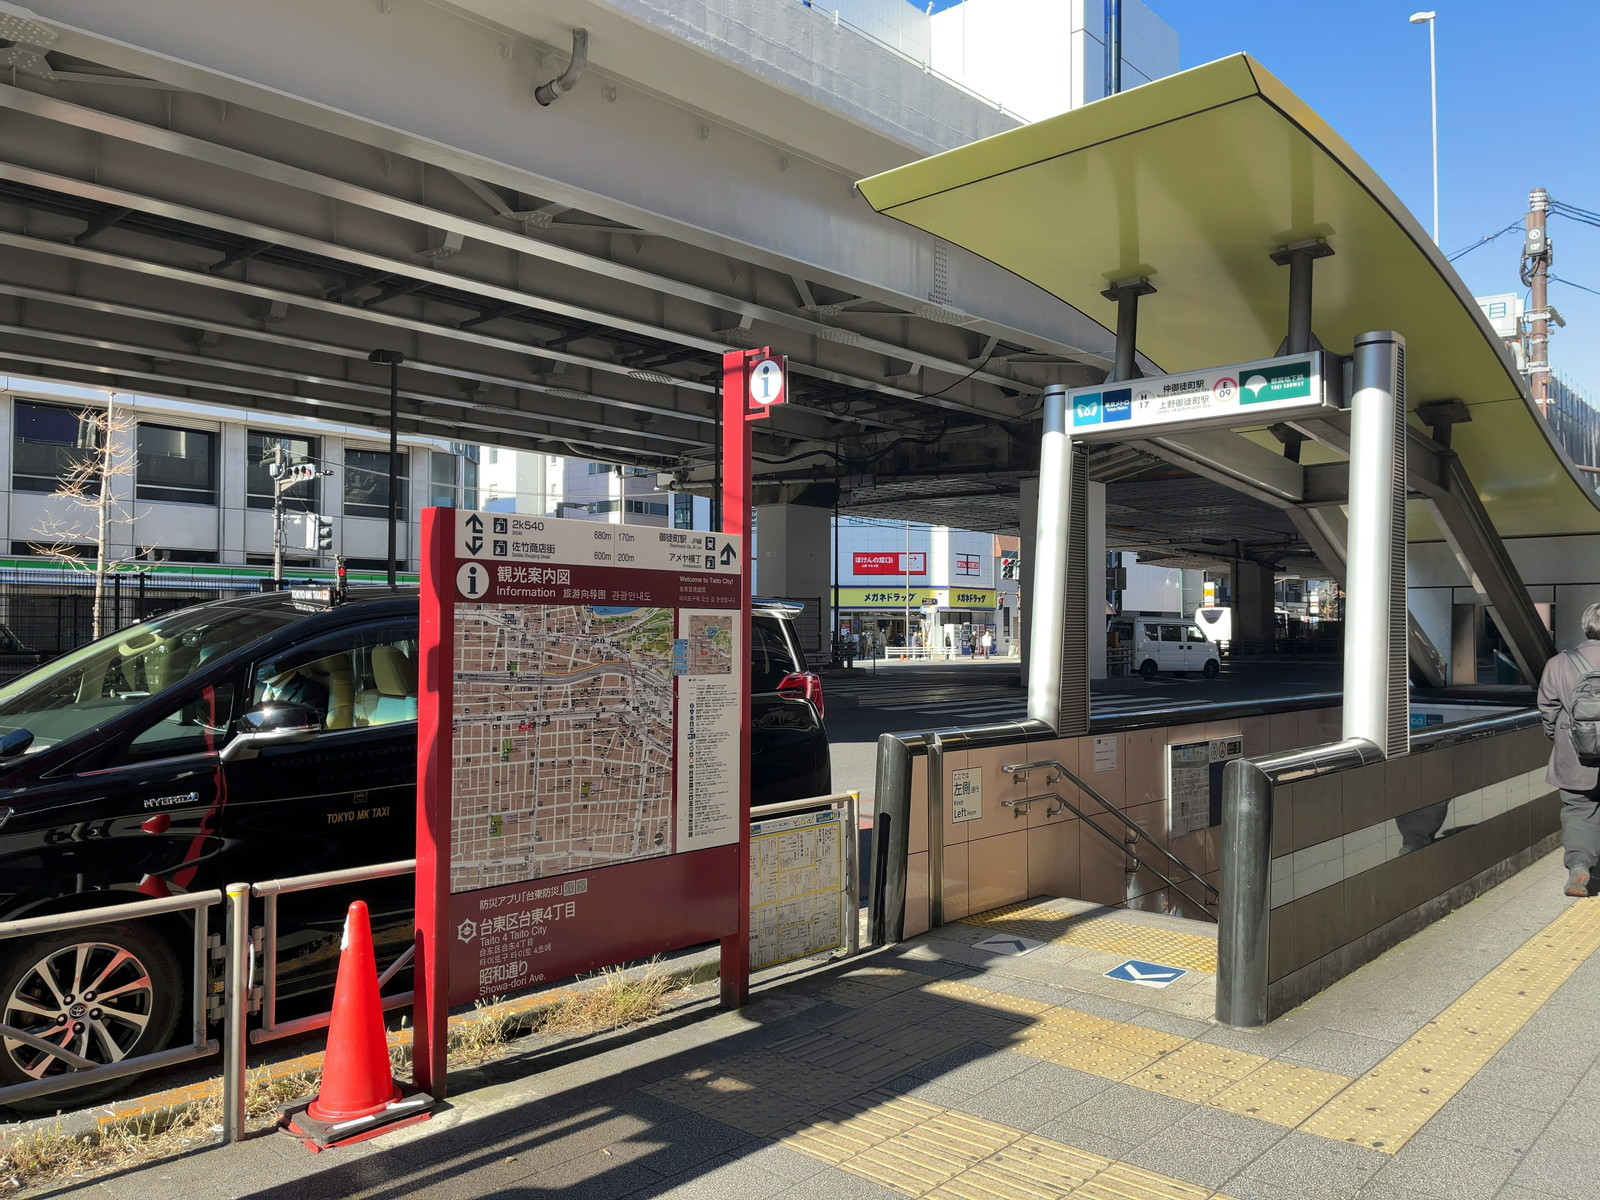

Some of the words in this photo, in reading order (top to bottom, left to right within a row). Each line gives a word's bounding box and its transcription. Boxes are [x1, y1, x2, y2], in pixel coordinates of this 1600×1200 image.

[1163, 380, 1205, 393] 仲御徒町駅
[1219, 389, 1231, 397] 09
[1159, 395, 1209, 409] 上野御徒町駅
[512, 520, 544, 531] 2k540
[594, 531, 611, 540] 680m
[618, 533, 634, 542] 170m
[659, 533, 687, 544] 御徒町駅
[512, 541, 555, 554] 佐竹商店街
[594, 552, 611, 561] 600m
[618, 553, 634, 562] 200m
[669, 553, 702, 564] アメヤ横丁
[497, 565, 571, 585] 観光案内図
[497, 586, 555, 598] Information
[957, 594, 986, 603] メガネドラッグ
[327, 812, 354, 823] TOKYO
[357, 810, 369, 819] MK
[372, 807, 390, 818] TAXI
[954, 808, 966, 818] Left
[480, 901, 576, 936] 台東区台東4丁目
[480, 936, 500, 947] Taito
[510, 929, 529, 940] Taito
[531, 925, 547, 936] City
[480, 938, 533, 958] 台东区台东4丁目
[480, 960, 528, 986] 昭和通り
[479, 979, 526, 996] Showa-dori
[529, 973, 546, 984] Ave.
